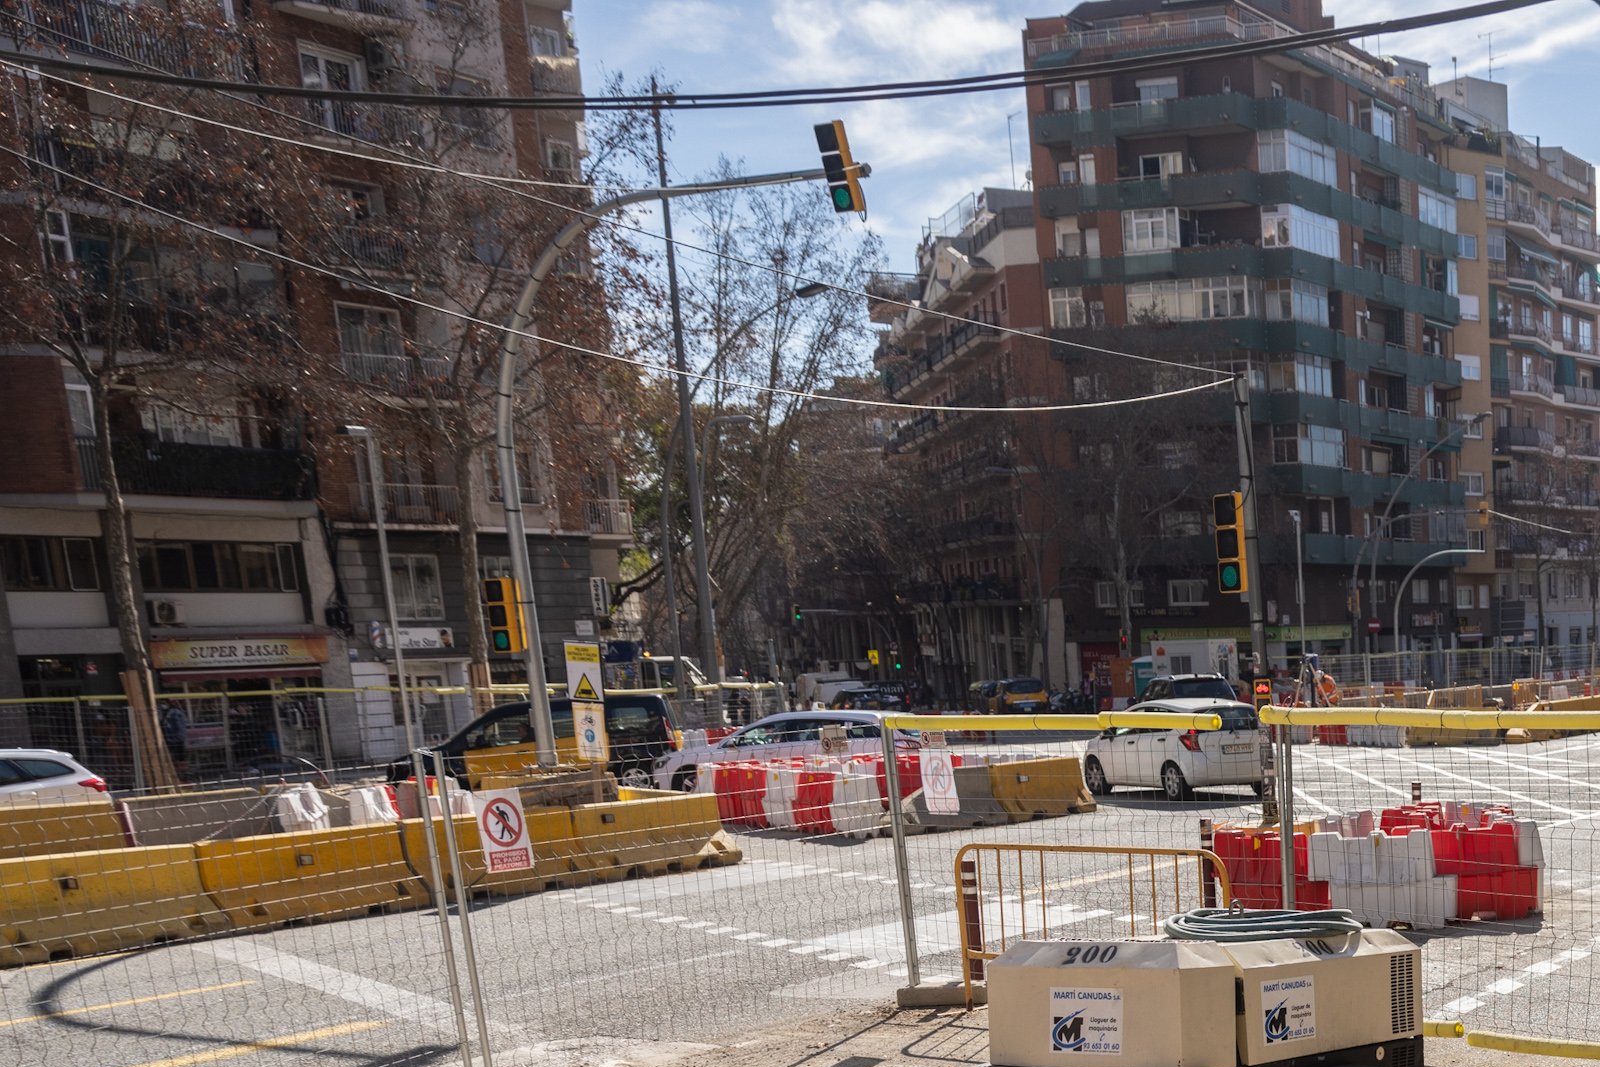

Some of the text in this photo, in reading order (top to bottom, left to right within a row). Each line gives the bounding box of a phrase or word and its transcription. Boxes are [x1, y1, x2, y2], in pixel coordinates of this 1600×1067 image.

[189, 644, 290, 659] SUPER BASAR
[492, 850, 526, 859] PROHIBIDO
[503, 855, 521, 863] PASO
[1061, 945, 1119, 965] 200
[1263, 981, 1280, 992] MARTÍ
[1281, 980, 1306, 990] CANUDAS
[1053, 989, 1075, 999] MARTÍ
[1078, 991, 1112, 1000] CANUDAS
